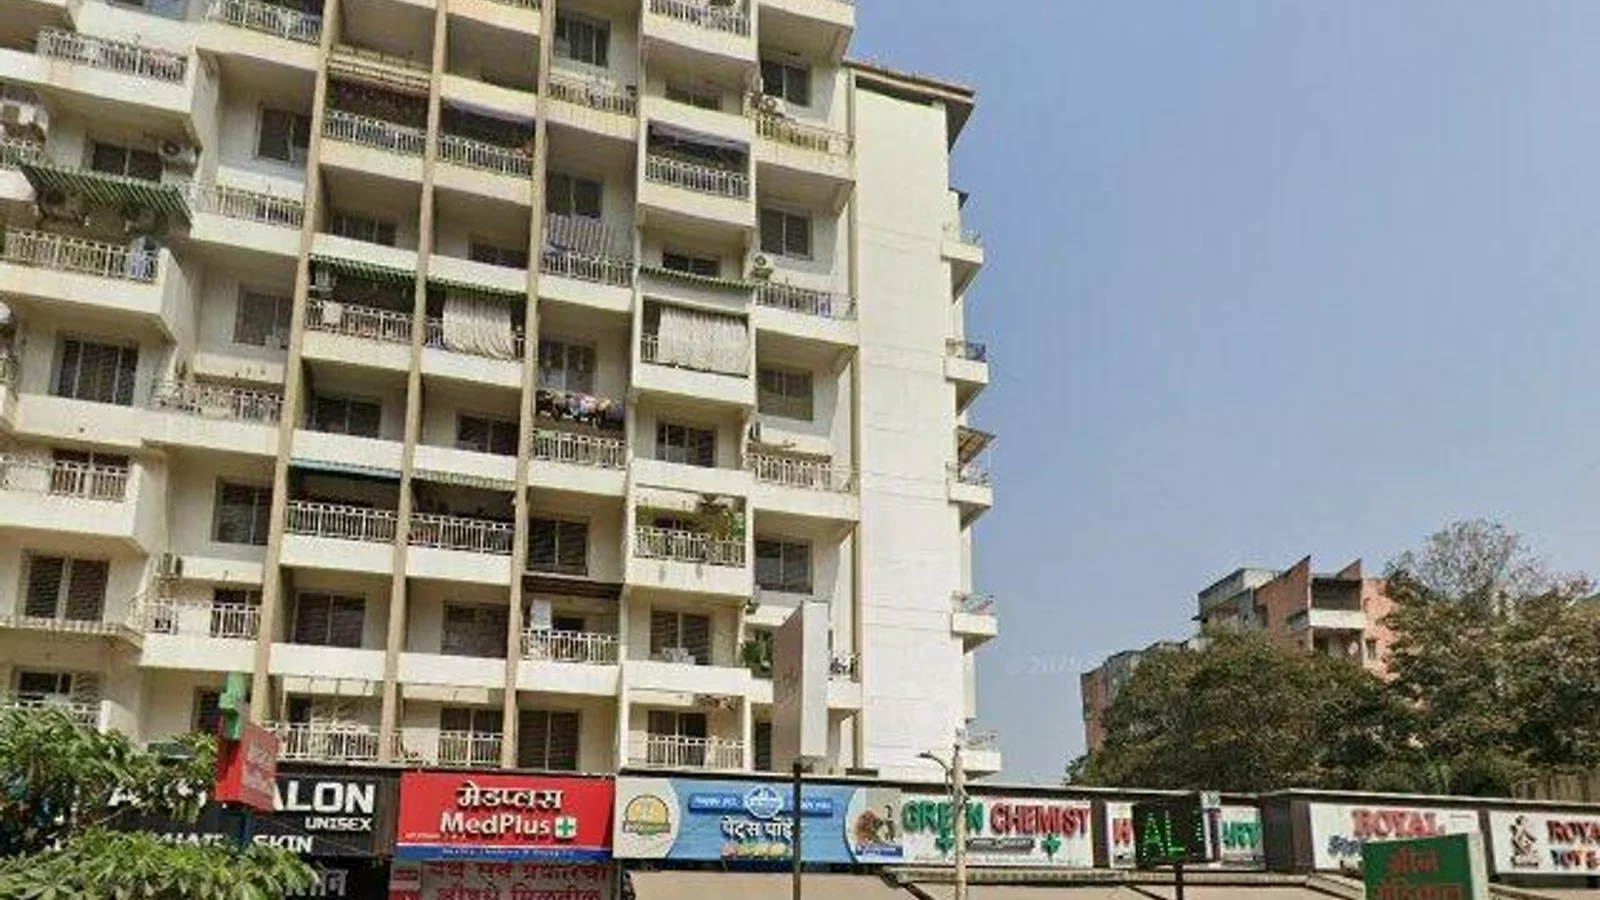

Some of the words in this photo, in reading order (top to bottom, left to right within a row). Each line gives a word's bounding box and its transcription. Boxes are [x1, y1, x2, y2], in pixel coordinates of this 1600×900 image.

[456, 780, 564, 809] मेडप्लस
[305, 816, 372, 832] UNISEX
[440, 812, 550, 834] MedPlus
[902, 800, 984, 834] GREN
[990, 804, 1089, 837] CHEMIST
